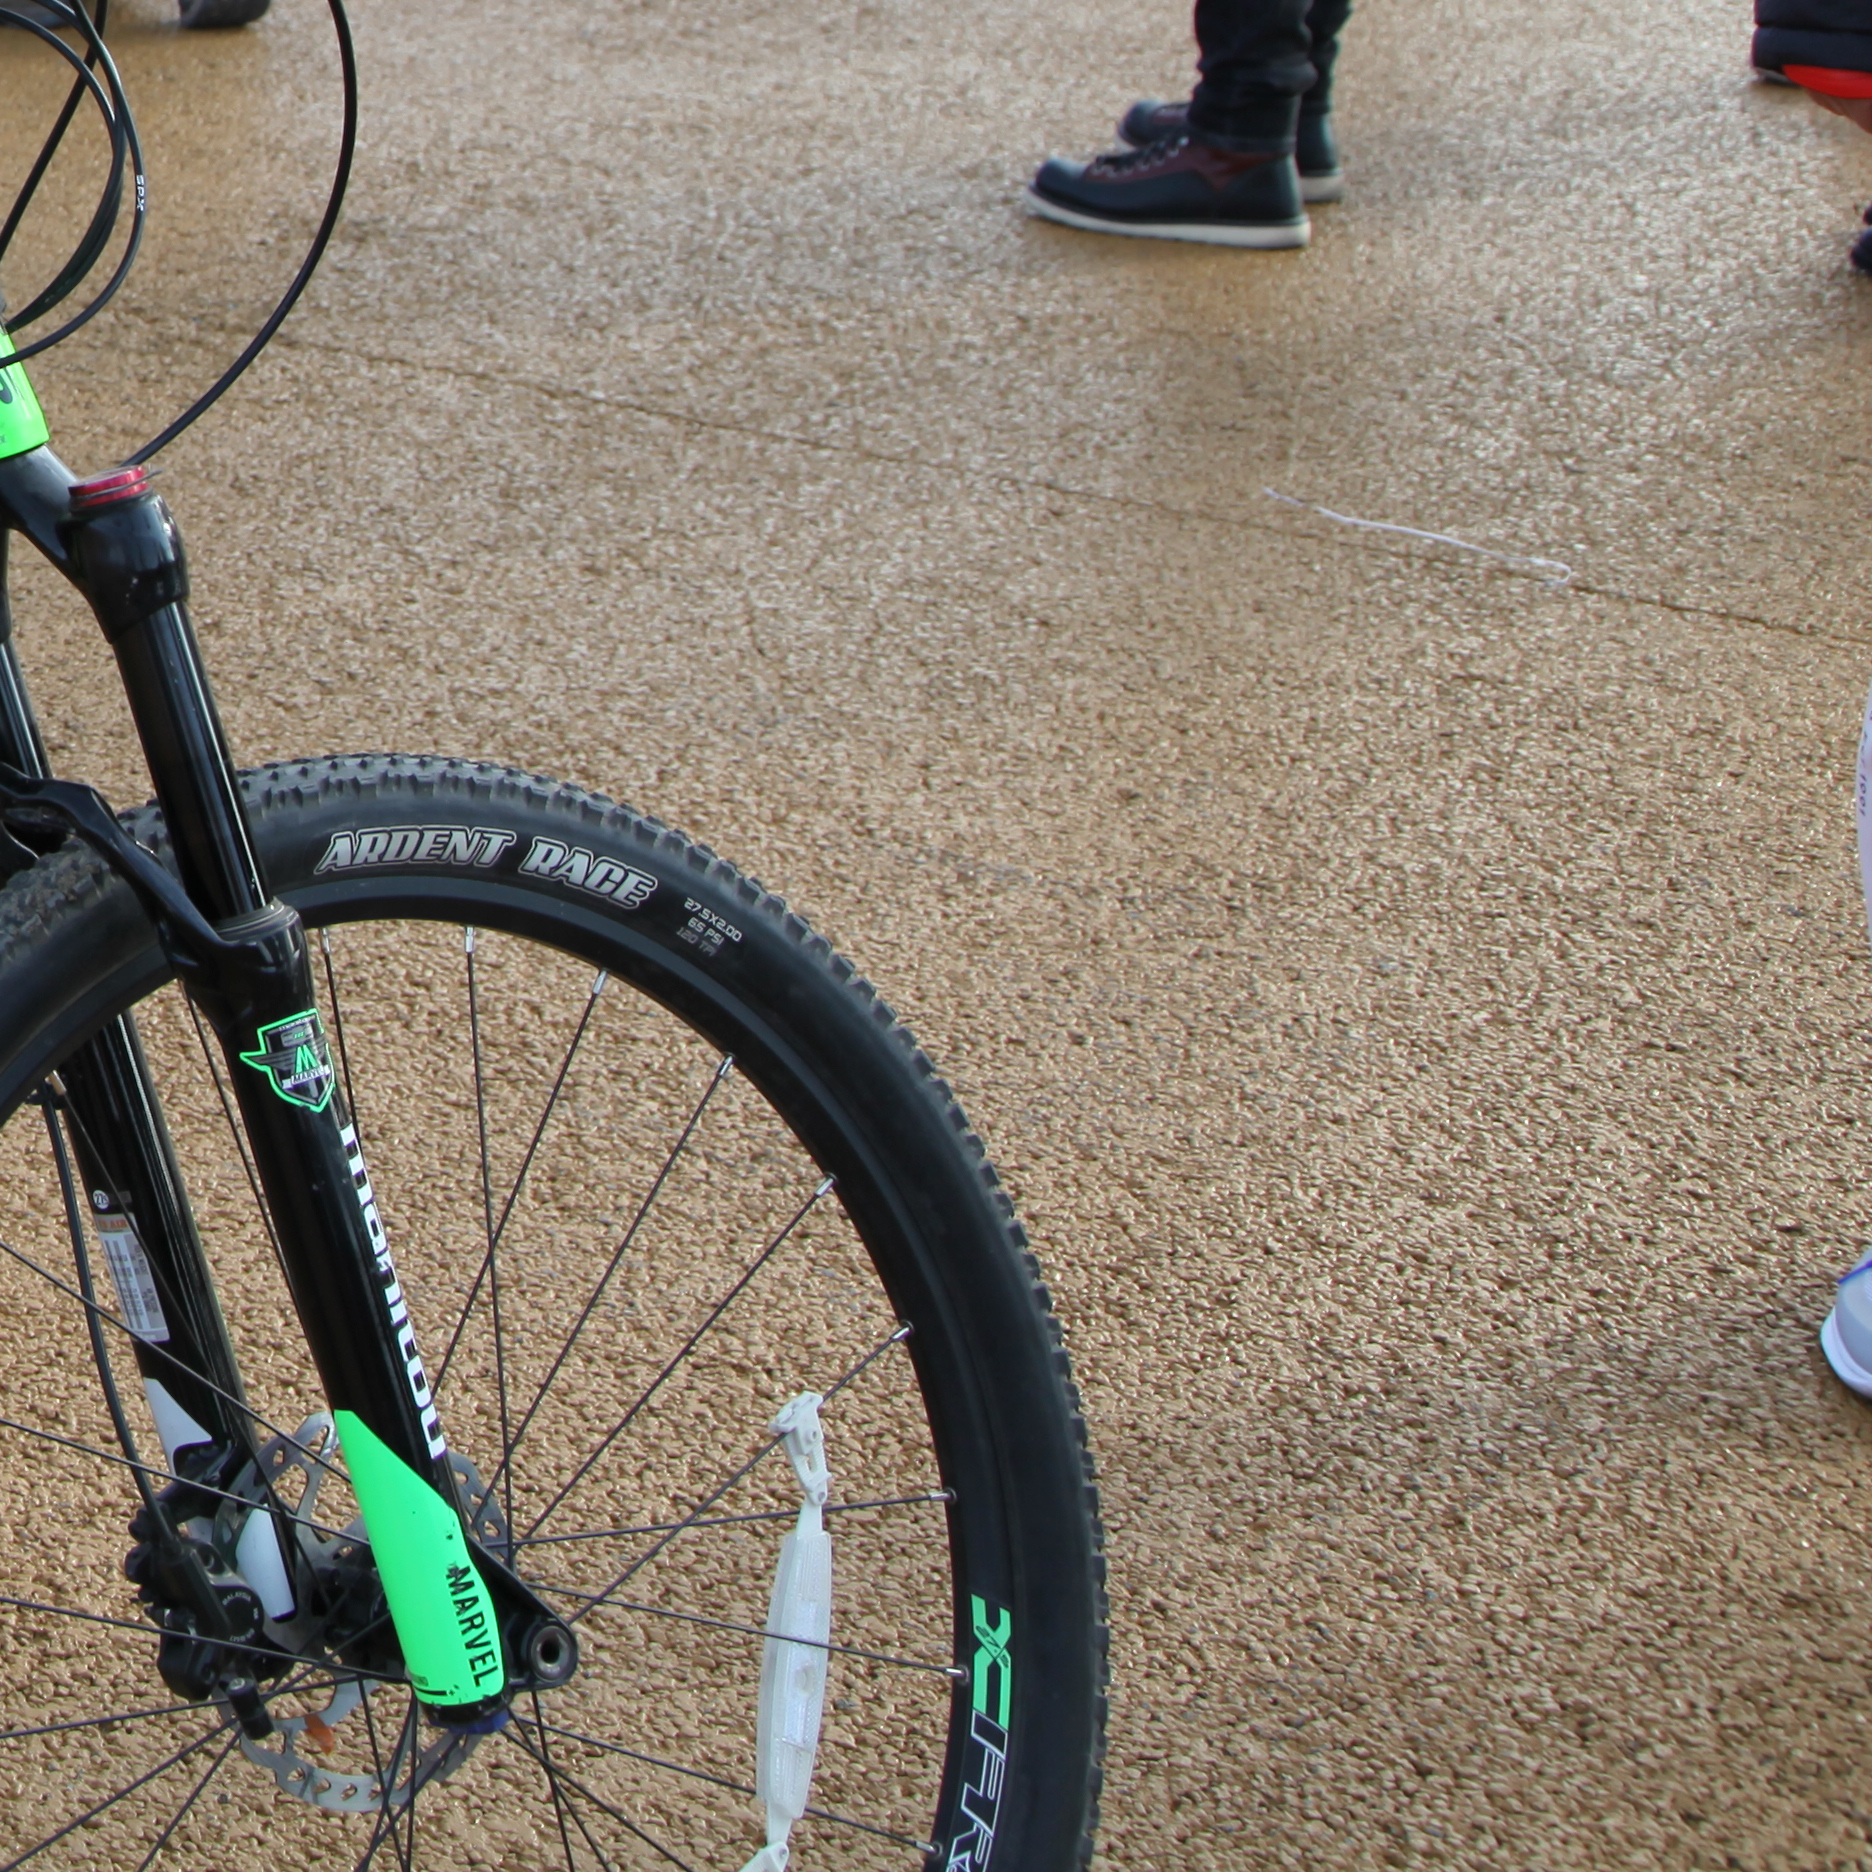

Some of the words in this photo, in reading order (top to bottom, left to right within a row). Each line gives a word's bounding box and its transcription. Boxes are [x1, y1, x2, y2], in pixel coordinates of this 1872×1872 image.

[314, 823, 517, 875] ARDENT
[518, 836, 659, 910] RACE
[704, 924, 726, 945] PSI
[446, 1564, 500, 1690] MARVEL
